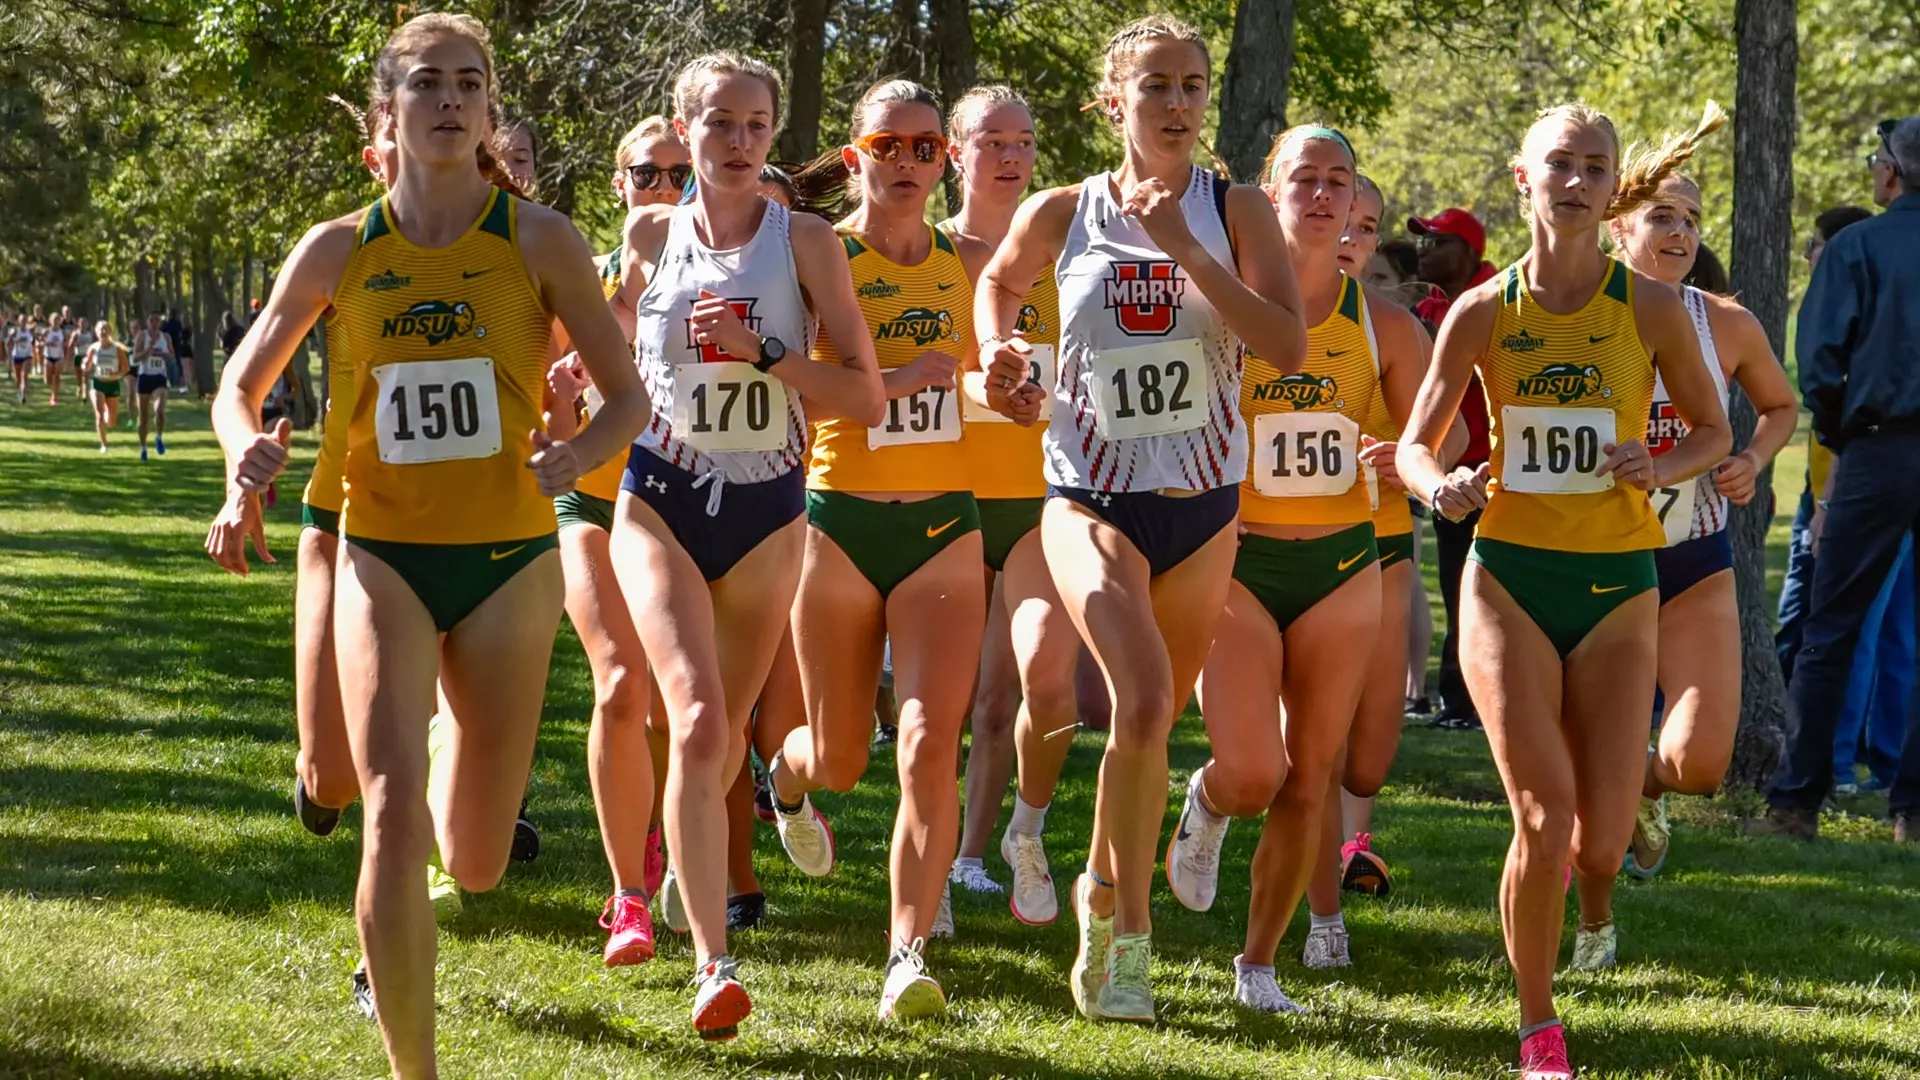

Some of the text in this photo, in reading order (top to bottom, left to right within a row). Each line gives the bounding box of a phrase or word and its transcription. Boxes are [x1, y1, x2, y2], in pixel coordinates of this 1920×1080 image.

[858, 284, 901, 296] SUMMIT
[1105, 279, 1186, 309] MARY
[381, 314, 450, 338] NDSU
[876, 320, 937, 340] NDSU
[1112, 360, 1192, 419] 182
[1252, 383, 1318, 402] NDSU
[1515, 376, 1581, 396] NDSU
[390, 381, 480, 441] 150
[691, 381, 770, 433] 170
[886, 385, 946, 433] 157
[1647, 417, 1688, 438] ARY
[1272, 430, 1341, 477] 156
[1521, 426, 1598, 474] 160
